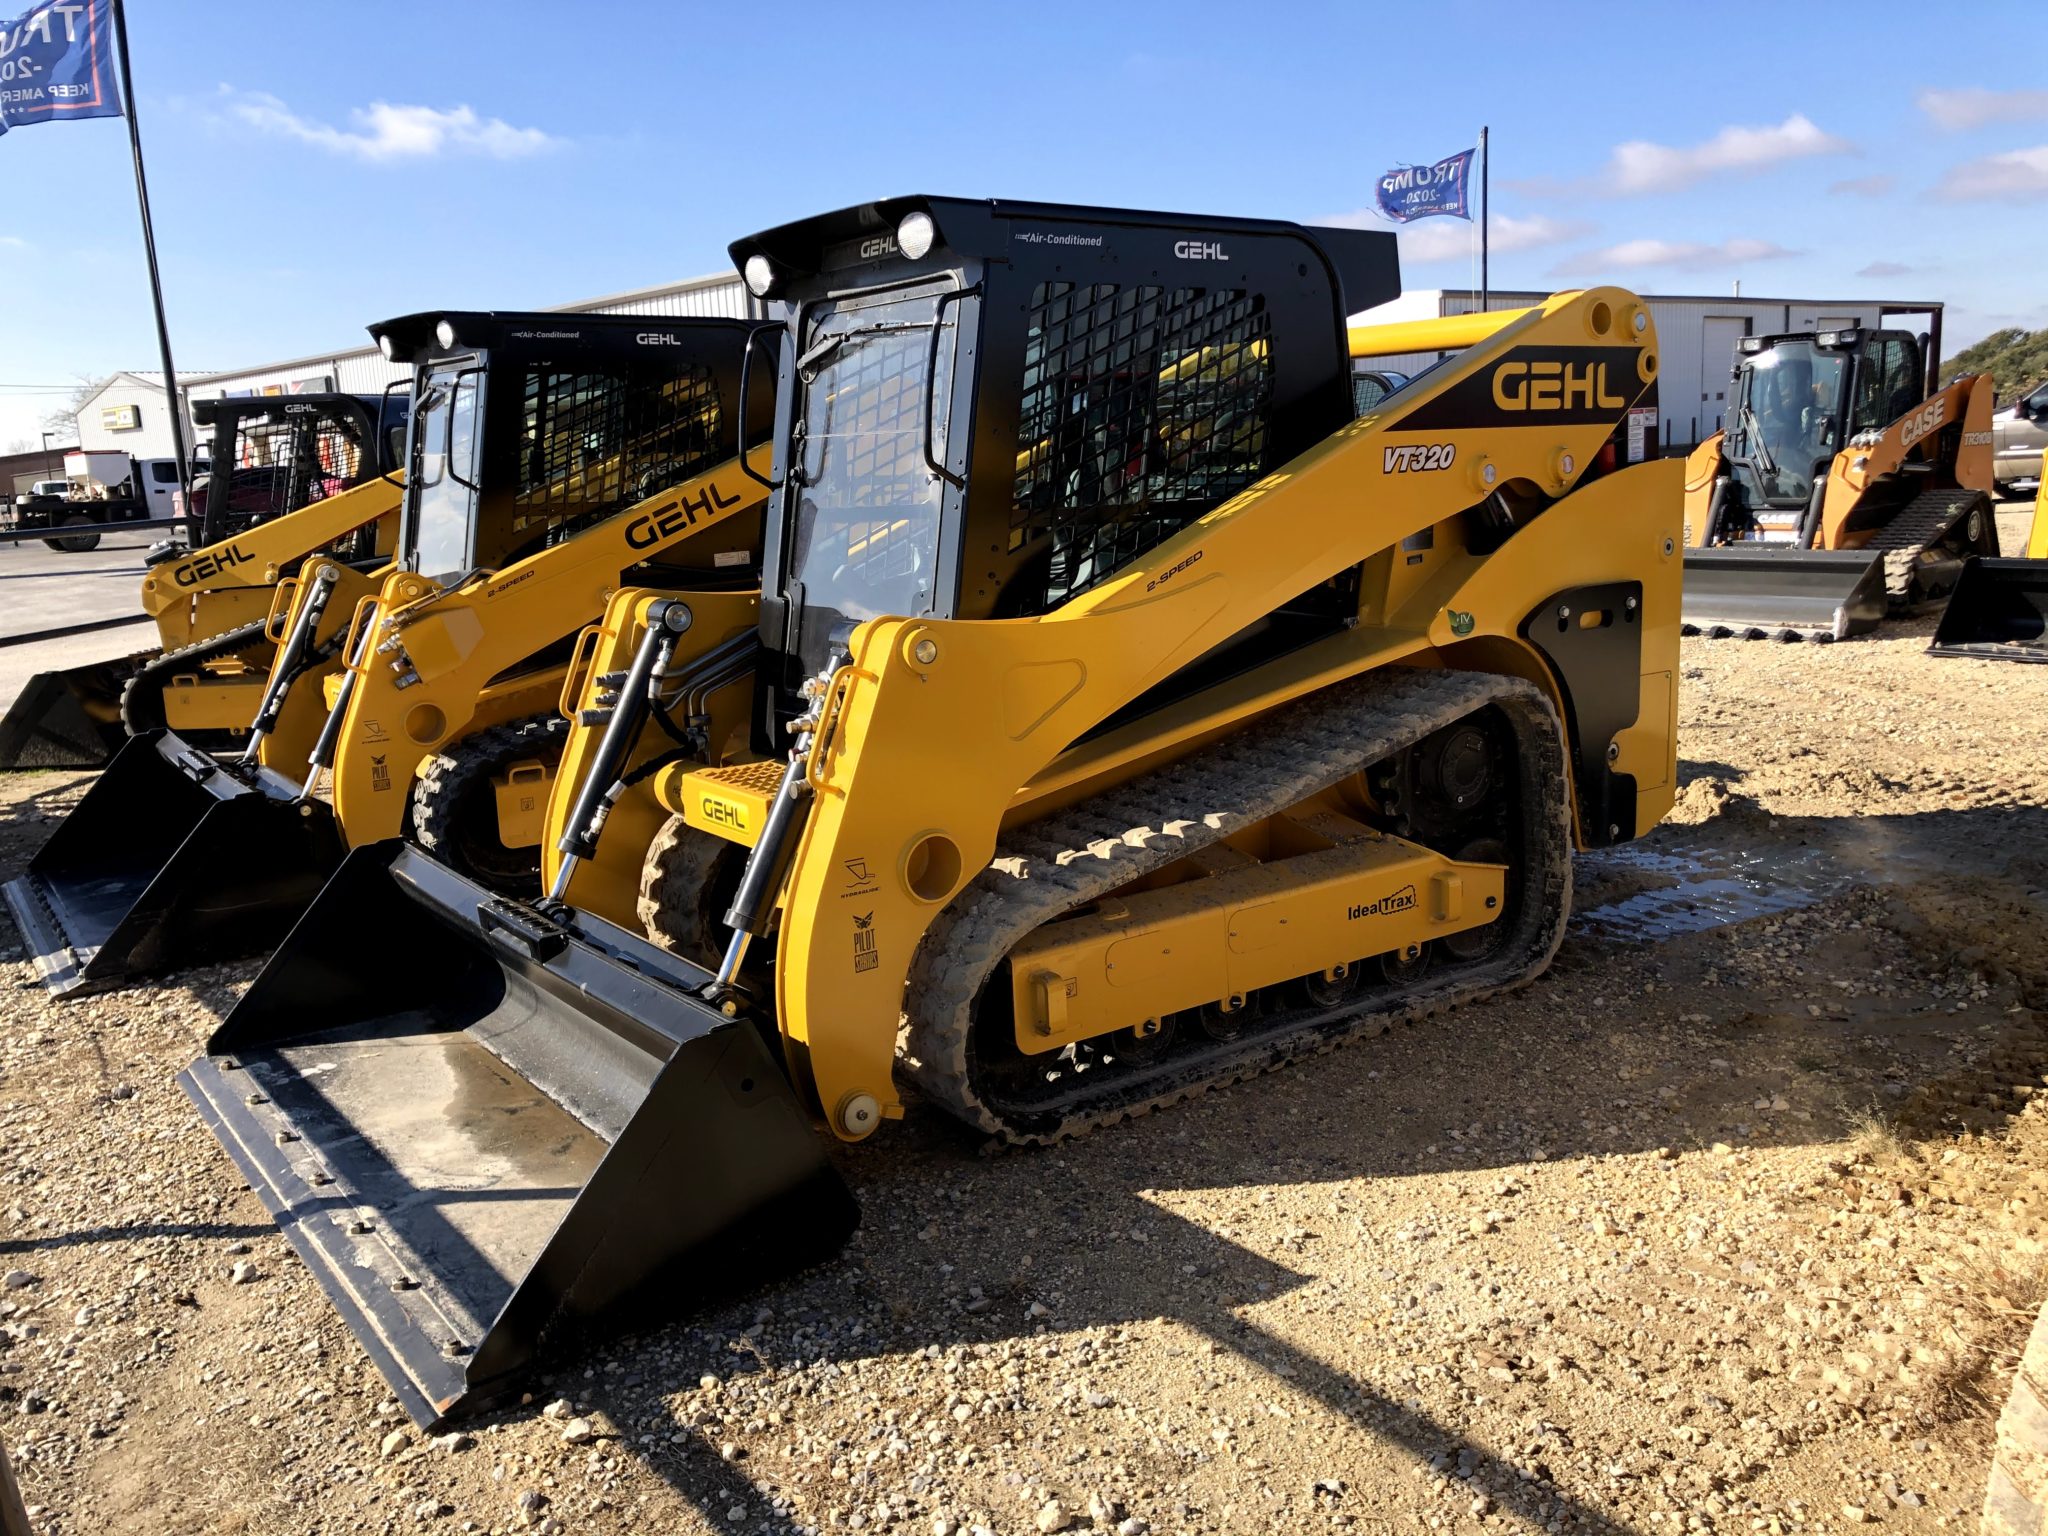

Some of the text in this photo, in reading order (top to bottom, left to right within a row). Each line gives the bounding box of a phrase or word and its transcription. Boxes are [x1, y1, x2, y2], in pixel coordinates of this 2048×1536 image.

[860, 235, 898, 258] GEHL
[1029, 232, 1103, 247] Air-Conditioned
[1174, 241, 1229, 261] GEHL
[522, 330, 580, 339] Air-Conditioned
[635, 332, 682, 346] GEHL
[1492, 361, 1625, 411] GEHL
[284, 403, 318, 414] GEHL
[1900, 397, 1945, 447] CASE
[1382, 443, 1457, 475] VT320
[624, 482, 742, 550] GEHL
[174, 543, 256, 587] GEHL
[1146, 550, 1203, 593] 2-SPEED
[487, 570, 535, 598] 2-SPEED
[702, 797, 746, 829] GEHL
[853, 928, 876, 954] PILOT
